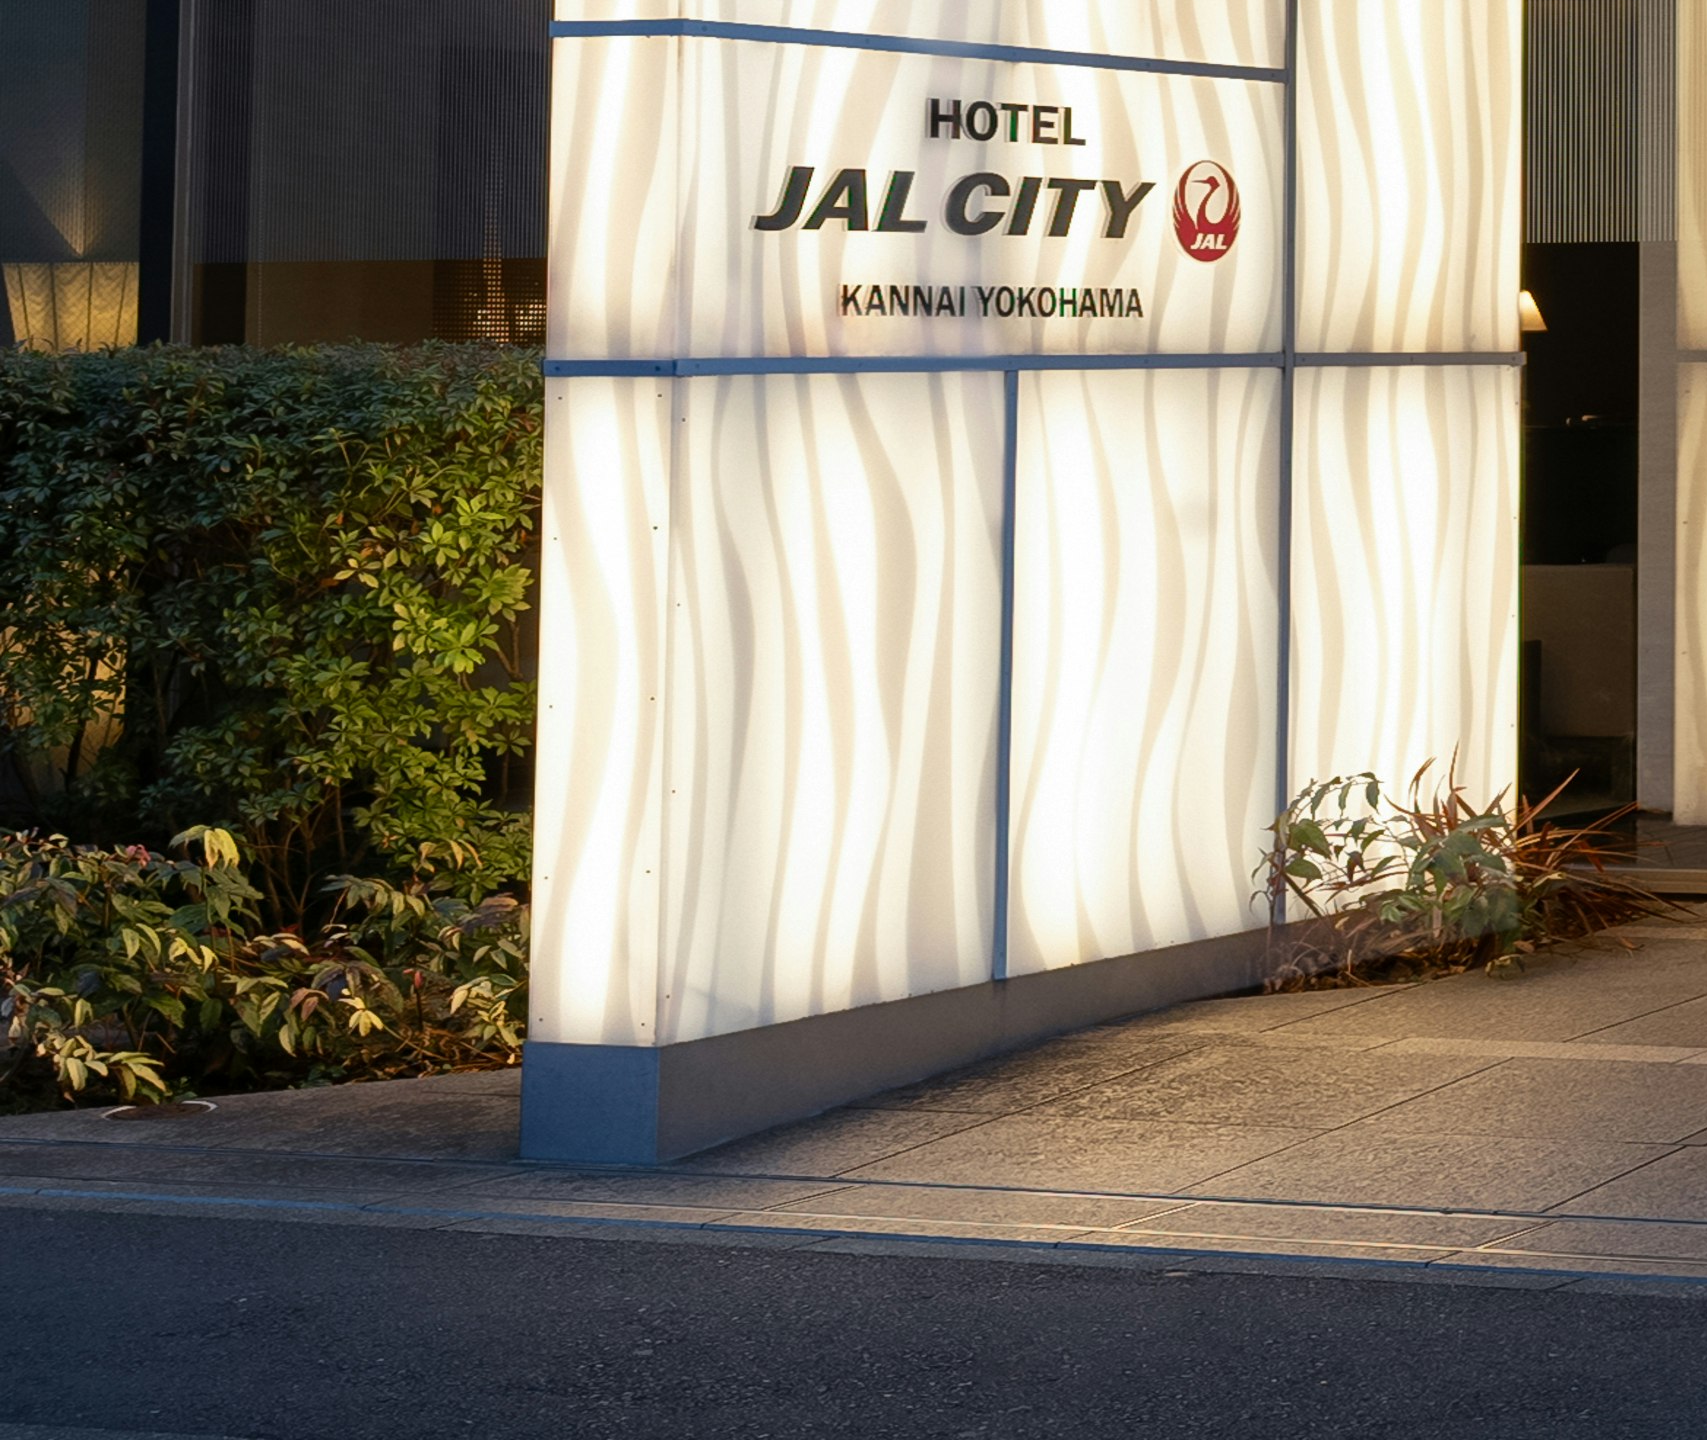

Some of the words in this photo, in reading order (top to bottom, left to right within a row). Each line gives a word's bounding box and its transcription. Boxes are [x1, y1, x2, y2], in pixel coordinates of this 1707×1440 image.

[928, 98, 1087, 147] HOTEL
[752, 164, 929, 234] JAL
[943, 171, 1157, 240] CITY
[1189, 232, 1228, 250] JAL
[841, 283, 966, 318] KANNAI
[977, 285, 1144, 319] YOKOHAMA
